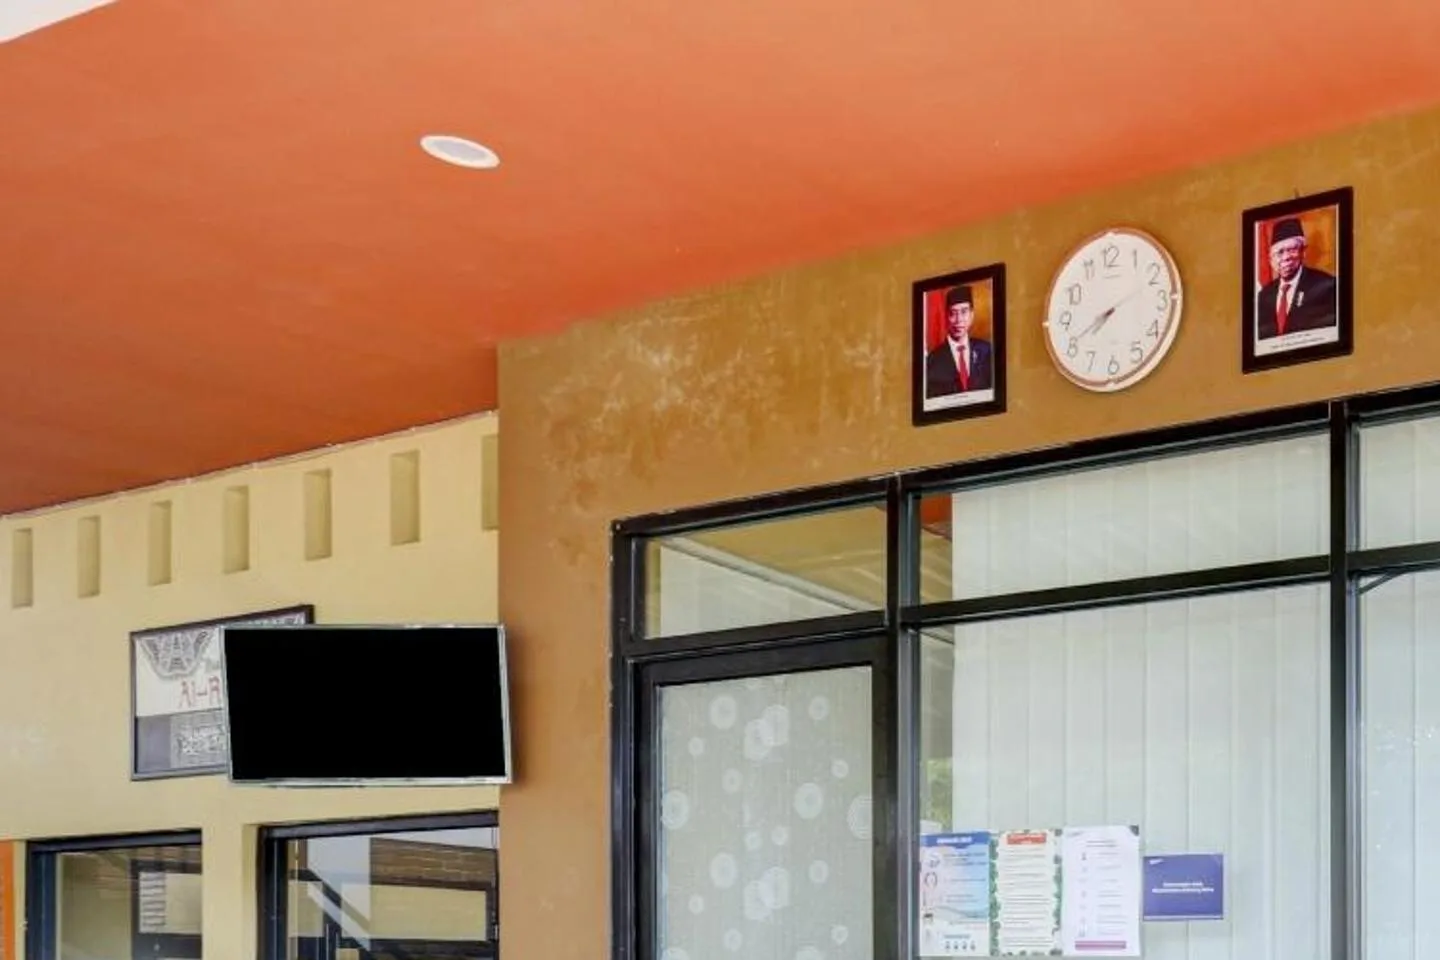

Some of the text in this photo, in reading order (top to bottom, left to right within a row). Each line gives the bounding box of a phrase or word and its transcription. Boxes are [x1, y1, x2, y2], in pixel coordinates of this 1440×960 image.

[1101, 246, 1120, 268] 12
[1132, 249, 1138, 271] 1
[1083, 259, 1095, 280] 11
[1147, 262, 1160, 286] 2
[1067, 283, 1081, 306] 10
[1157, 289, 1167, 312] 3
[1059, 310, 1072, 331] 9
[1146, 319, 1158, 339] 4
[1066, 336, 1078, 358] 8
[1130, 340, 1143, 364] 5
[1086, 350, 1095, 373] 7
[1107, 355, 1120, 375] 6
